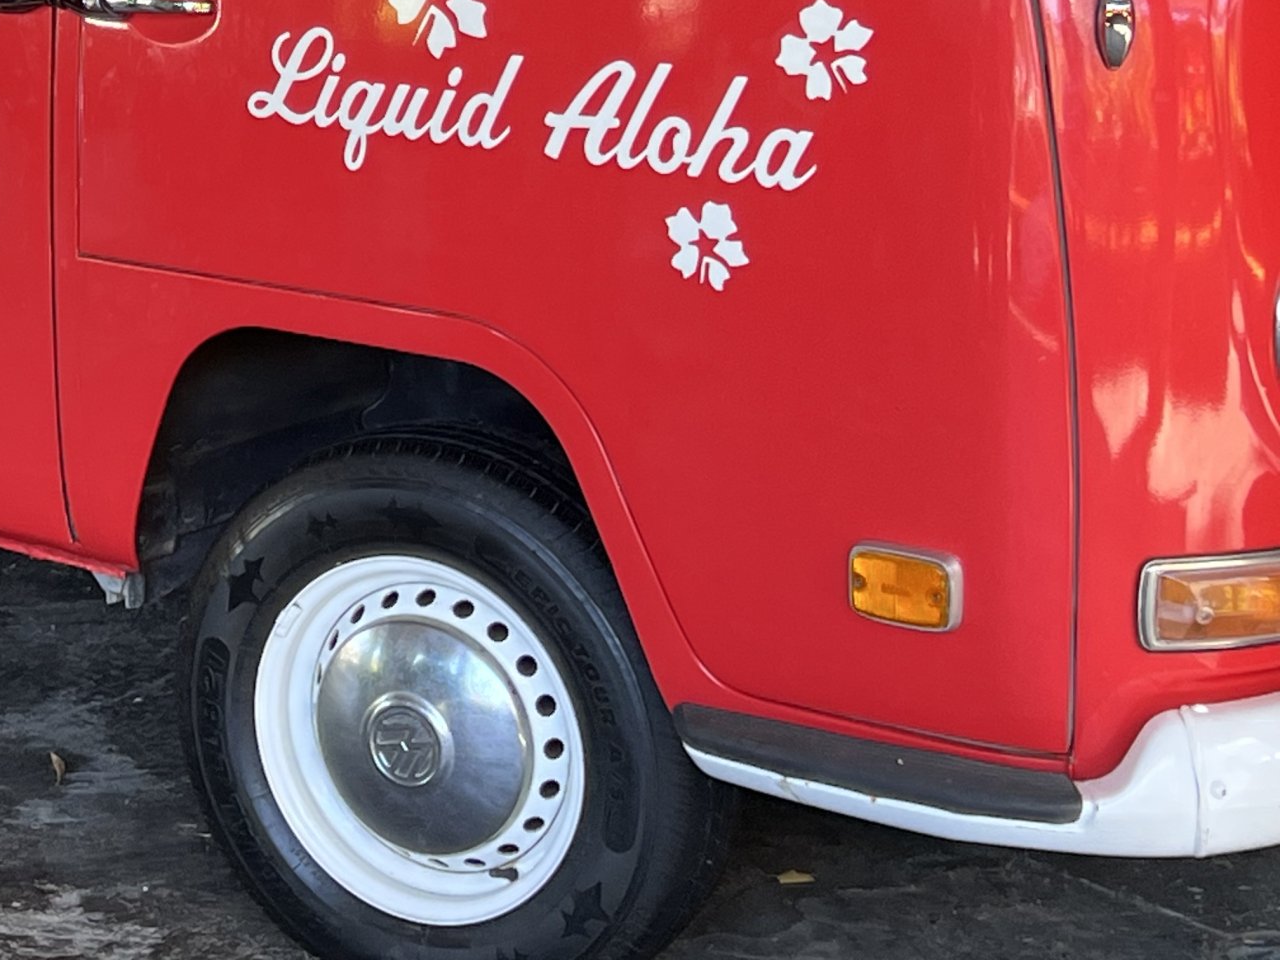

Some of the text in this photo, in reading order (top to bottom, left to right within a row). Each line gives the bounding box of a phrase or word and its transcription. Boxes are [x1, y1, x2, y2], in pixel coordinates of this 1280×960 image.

[246, 26, 818, 191] Liquid Aloha
[572, 642, 618, 726] TOUR
